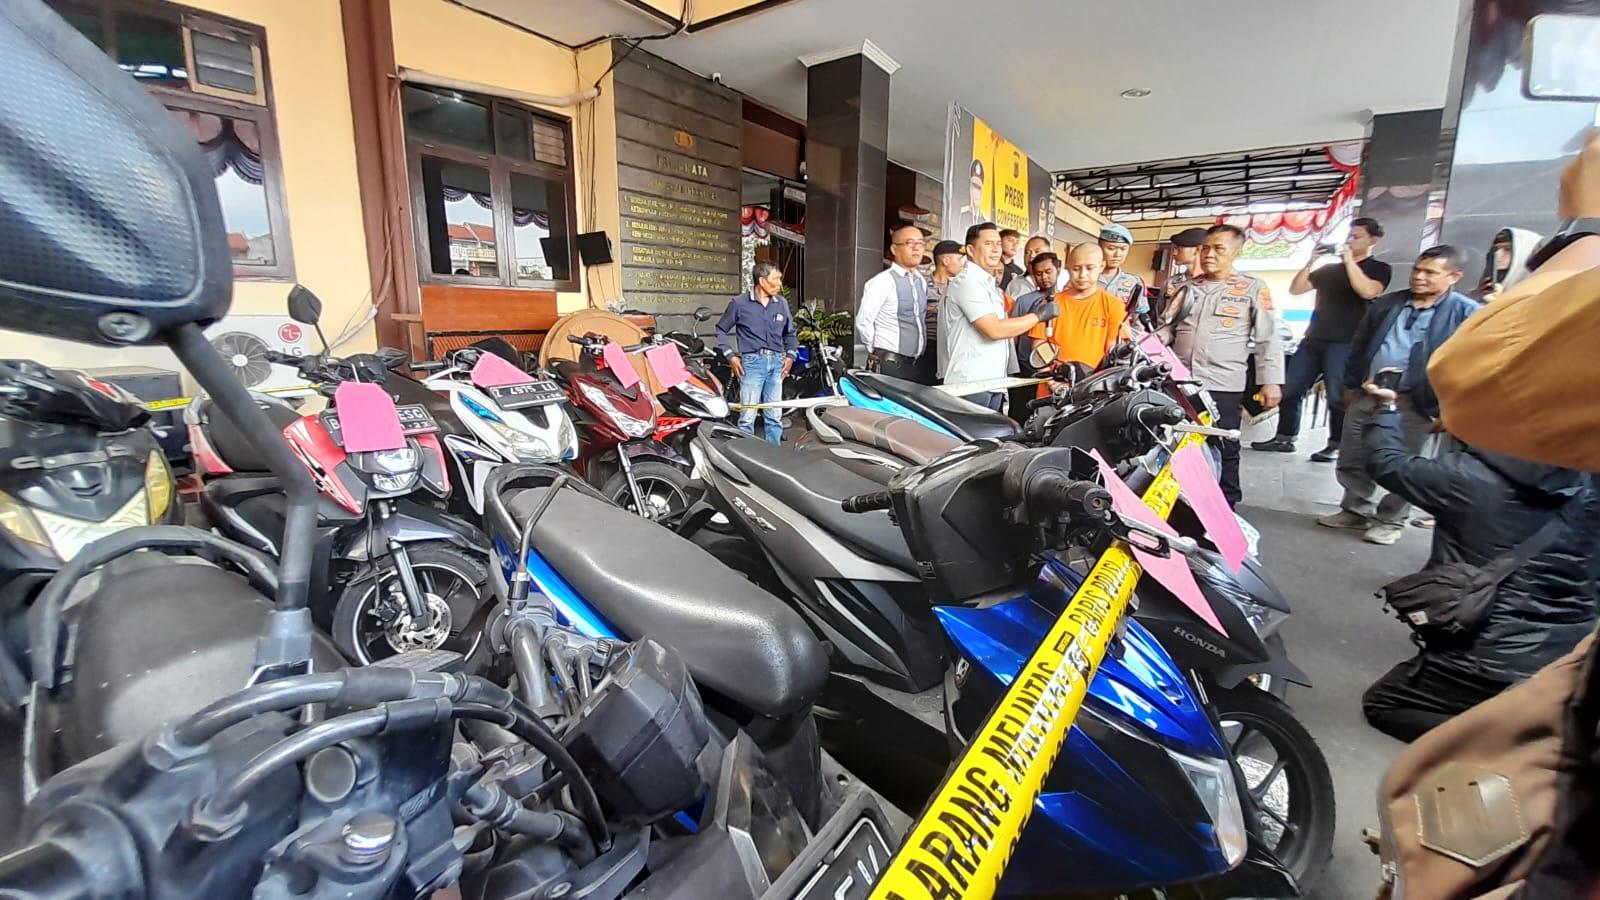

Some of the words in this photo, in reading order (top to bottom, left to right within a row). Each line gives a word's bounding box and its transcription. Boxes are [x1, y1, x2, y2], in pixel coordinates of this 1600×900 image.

[1004, 184, 1024, 210] PRESS
[997, 208, 1028, 232] CONFERENCE
[329, 418, 340, 430] B
[1173, 626, 1226, 658] HONDA
[886, 767, 1012, 900] ARANG
[981, 661, 1071, 785] MELINTAS
